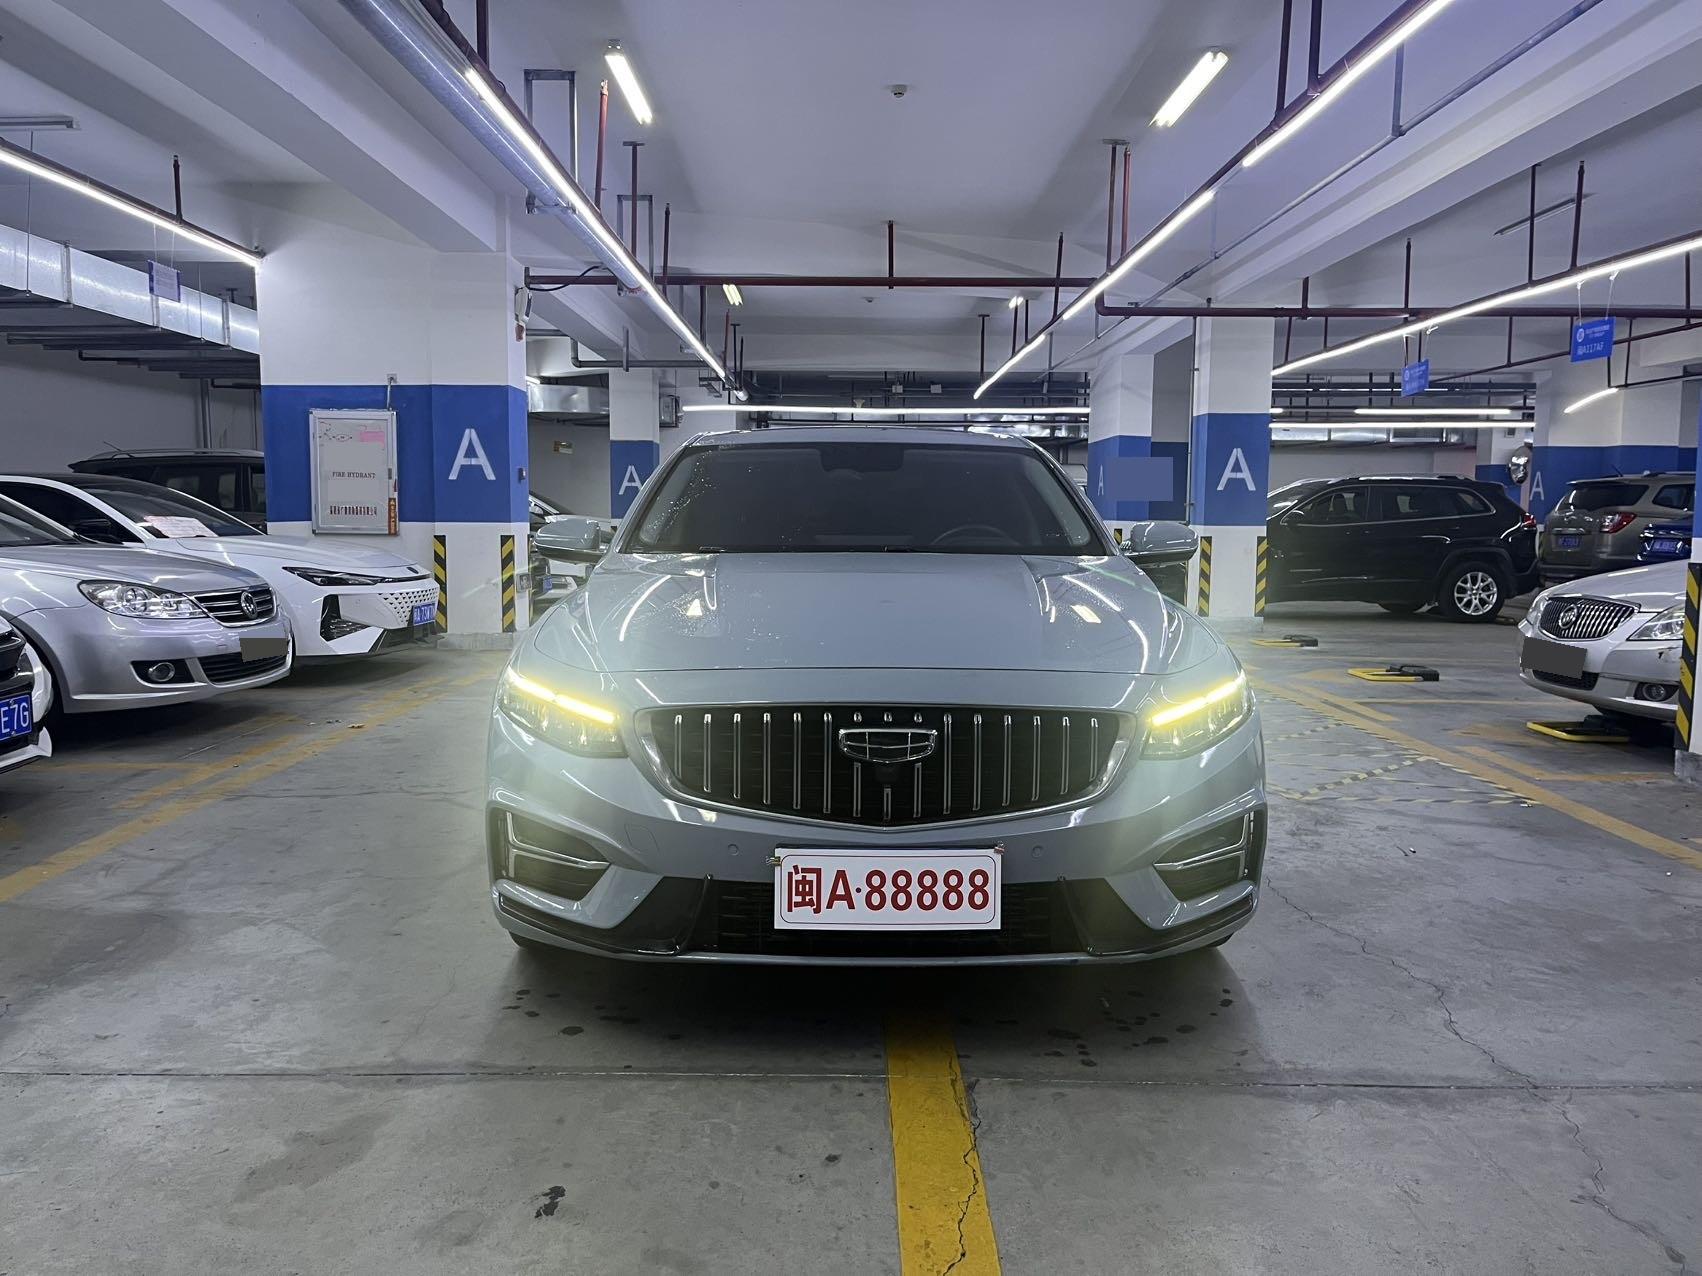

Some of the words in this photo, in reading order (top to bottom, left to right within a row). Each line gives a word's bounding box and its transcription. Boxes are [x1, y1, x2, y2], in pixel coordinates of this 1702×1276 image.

[448, 428, 496, 480] A
[1216, 448, 1256, 491] A
[347, 471, 376, 479] HYDRANT
[618, 465, 643, 495] A
[1097, 464, 1104, 496] A
[1530, 471, 1544, 500] A
[0, 702, 29, 734] E7G
